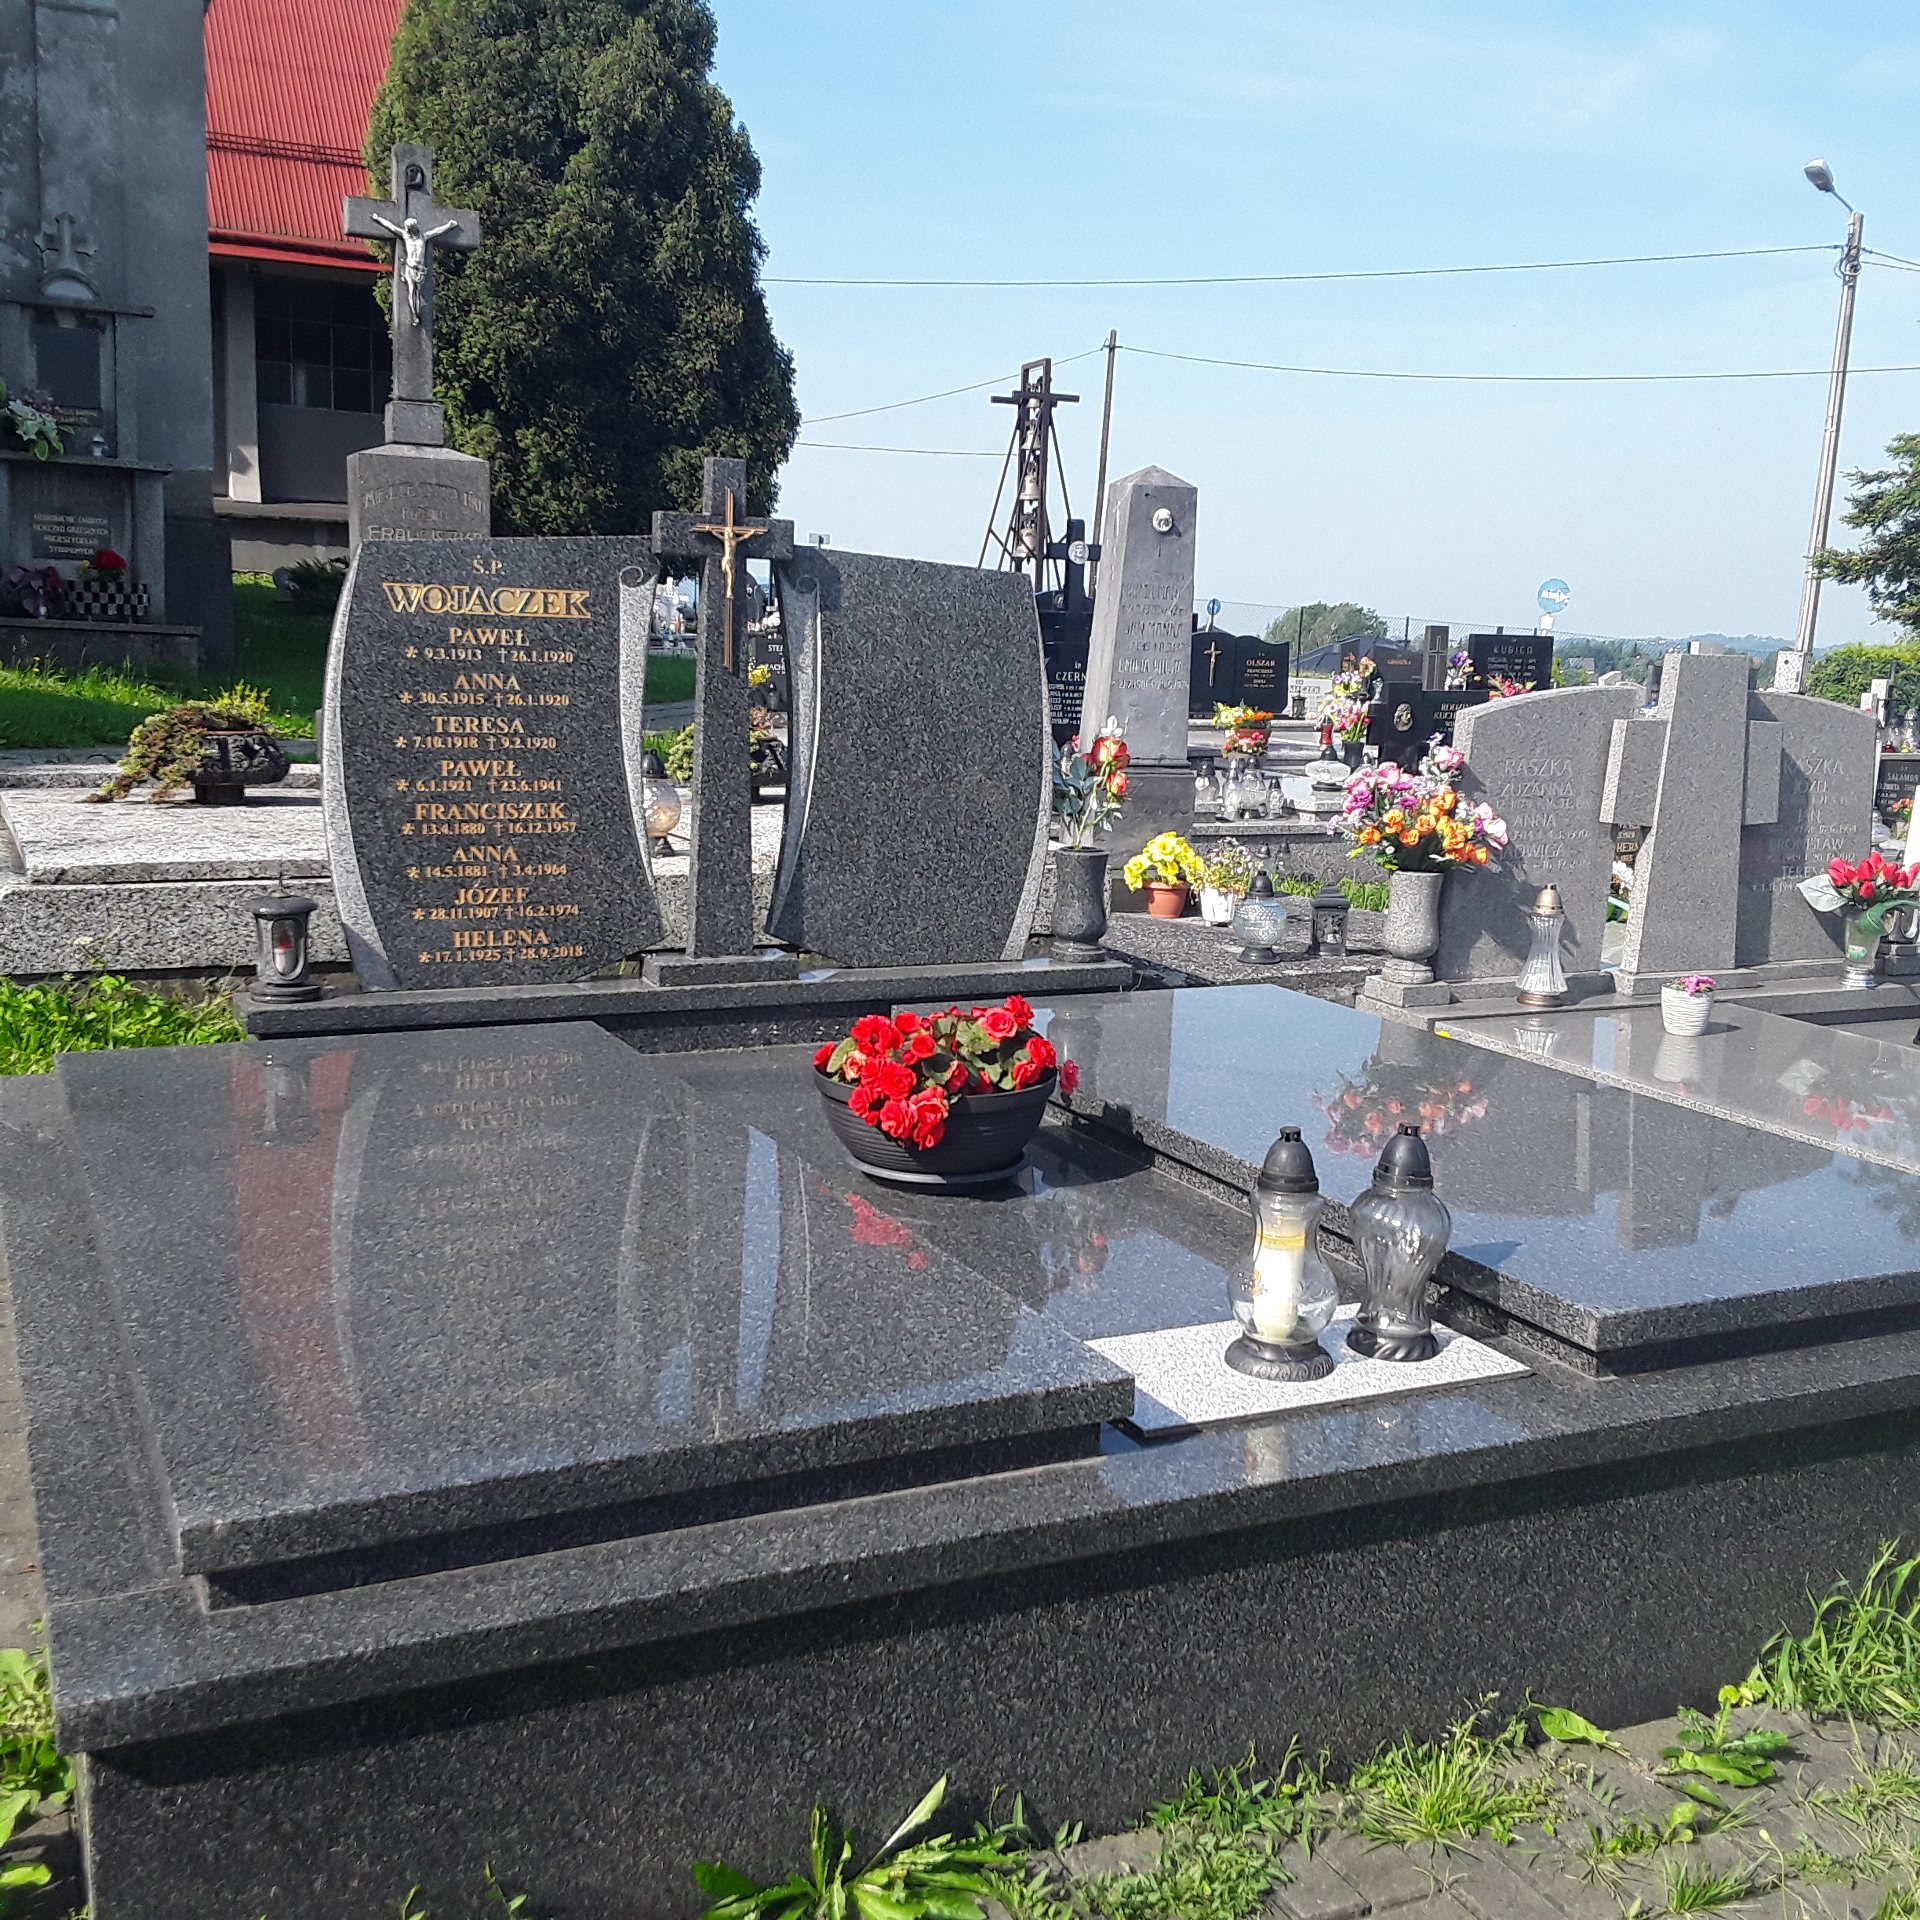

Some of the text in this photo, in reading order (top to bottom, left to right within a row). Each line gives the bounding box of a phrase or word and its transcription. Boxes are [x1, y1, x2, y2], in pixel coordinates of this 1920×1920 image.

[382, 582, 592, 618] WOJACZEK
[449, 627, 530, 646] PAWEŁ
[423, 648, 574, 663] 9.3.1913 26.1.1920
[1493, 645, 1533, 655] KUBICA
[454, 673, 521, 690] ANNA
[419, 691, 570, 706] 30.5.1915 26.1.1920
[432, 716, 525, 734] TERESA
[413, 736, 557, 749] 7.10.1918 9.2.1920
[441, 760, 522, 777] PAWEŁ
[1504, 759, 1573, 777] RASZKA
[416, 780, 562, 792] 6.1.1921 23.6.1941
[415, 803, 569, 820] FRANCISZEK
[422, 822, 577, 835] 13.4.1880 16.12.1957
[1512, 813, 1557, 828] ANNA
[453, 846, 519, 862] ANNA
[426, 864, 568, 878] 14.5.1881 3.4.1964
[454, 880, 530, 905] JÓZEF
[429, 904, 580, 920] 28.11.1907 16.2.1974
[453, 930, 550, 948] HELENA
